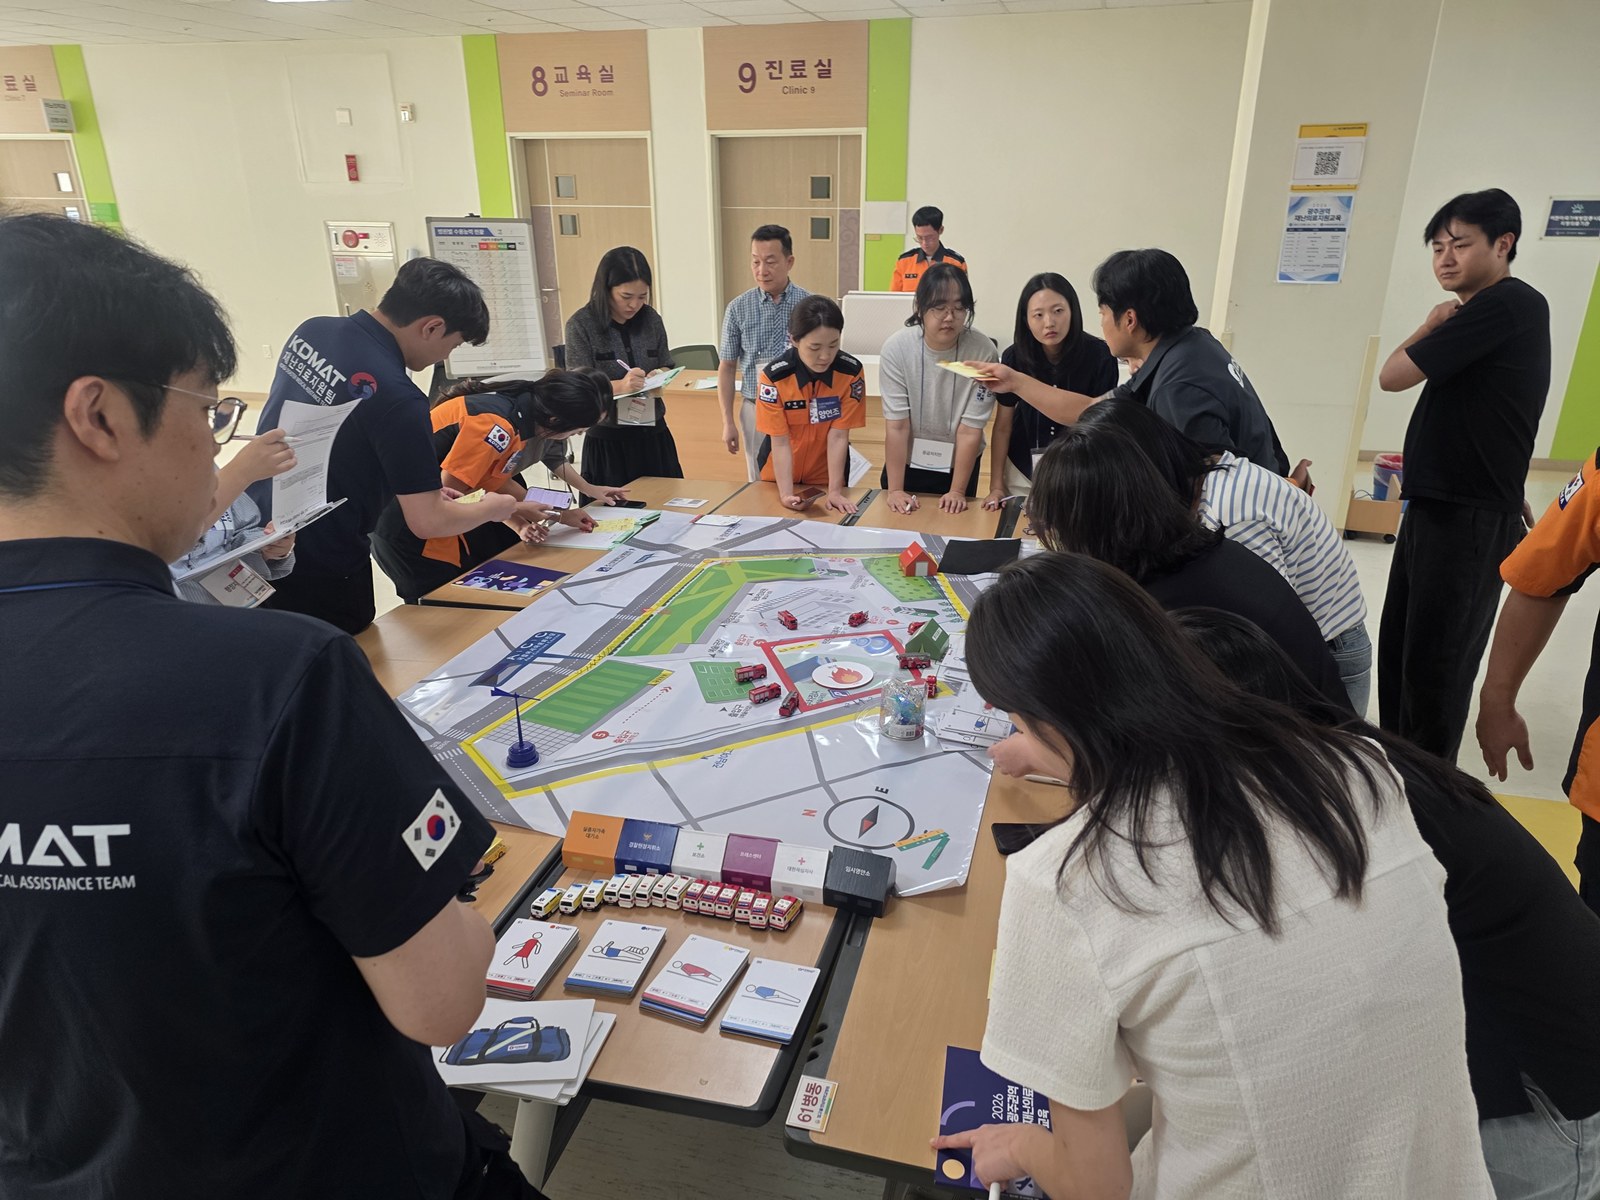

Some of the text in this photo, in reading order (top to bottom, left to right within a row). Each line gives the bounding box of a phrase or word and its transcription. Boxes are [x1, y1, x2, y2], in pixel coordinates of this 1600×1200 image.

[532, 64, 614, 97] 8 교육실
[738, 59, 832, 94] 9 진료실
[560, 89, 614, 98] Seminar Room
[782, 86, 816, 95] Clinic 9
[288, 335, 347, 387] KDMAT
[875, 786, 889, 794] E
[802, 809, 817, 817] N
[844, 865, 871, 877] 임시영안소
[20, 876, 93, 890] ASSISTANCE
[95, 875, 136, 890] TEAM
[797, 1082, 822, 1123] 61병동
[992, 1093, 1004, 1120] 2026
[1006, 1085, 1019, 1122] 광주권역
[1037, 1109, 1050, 1129] 교육
